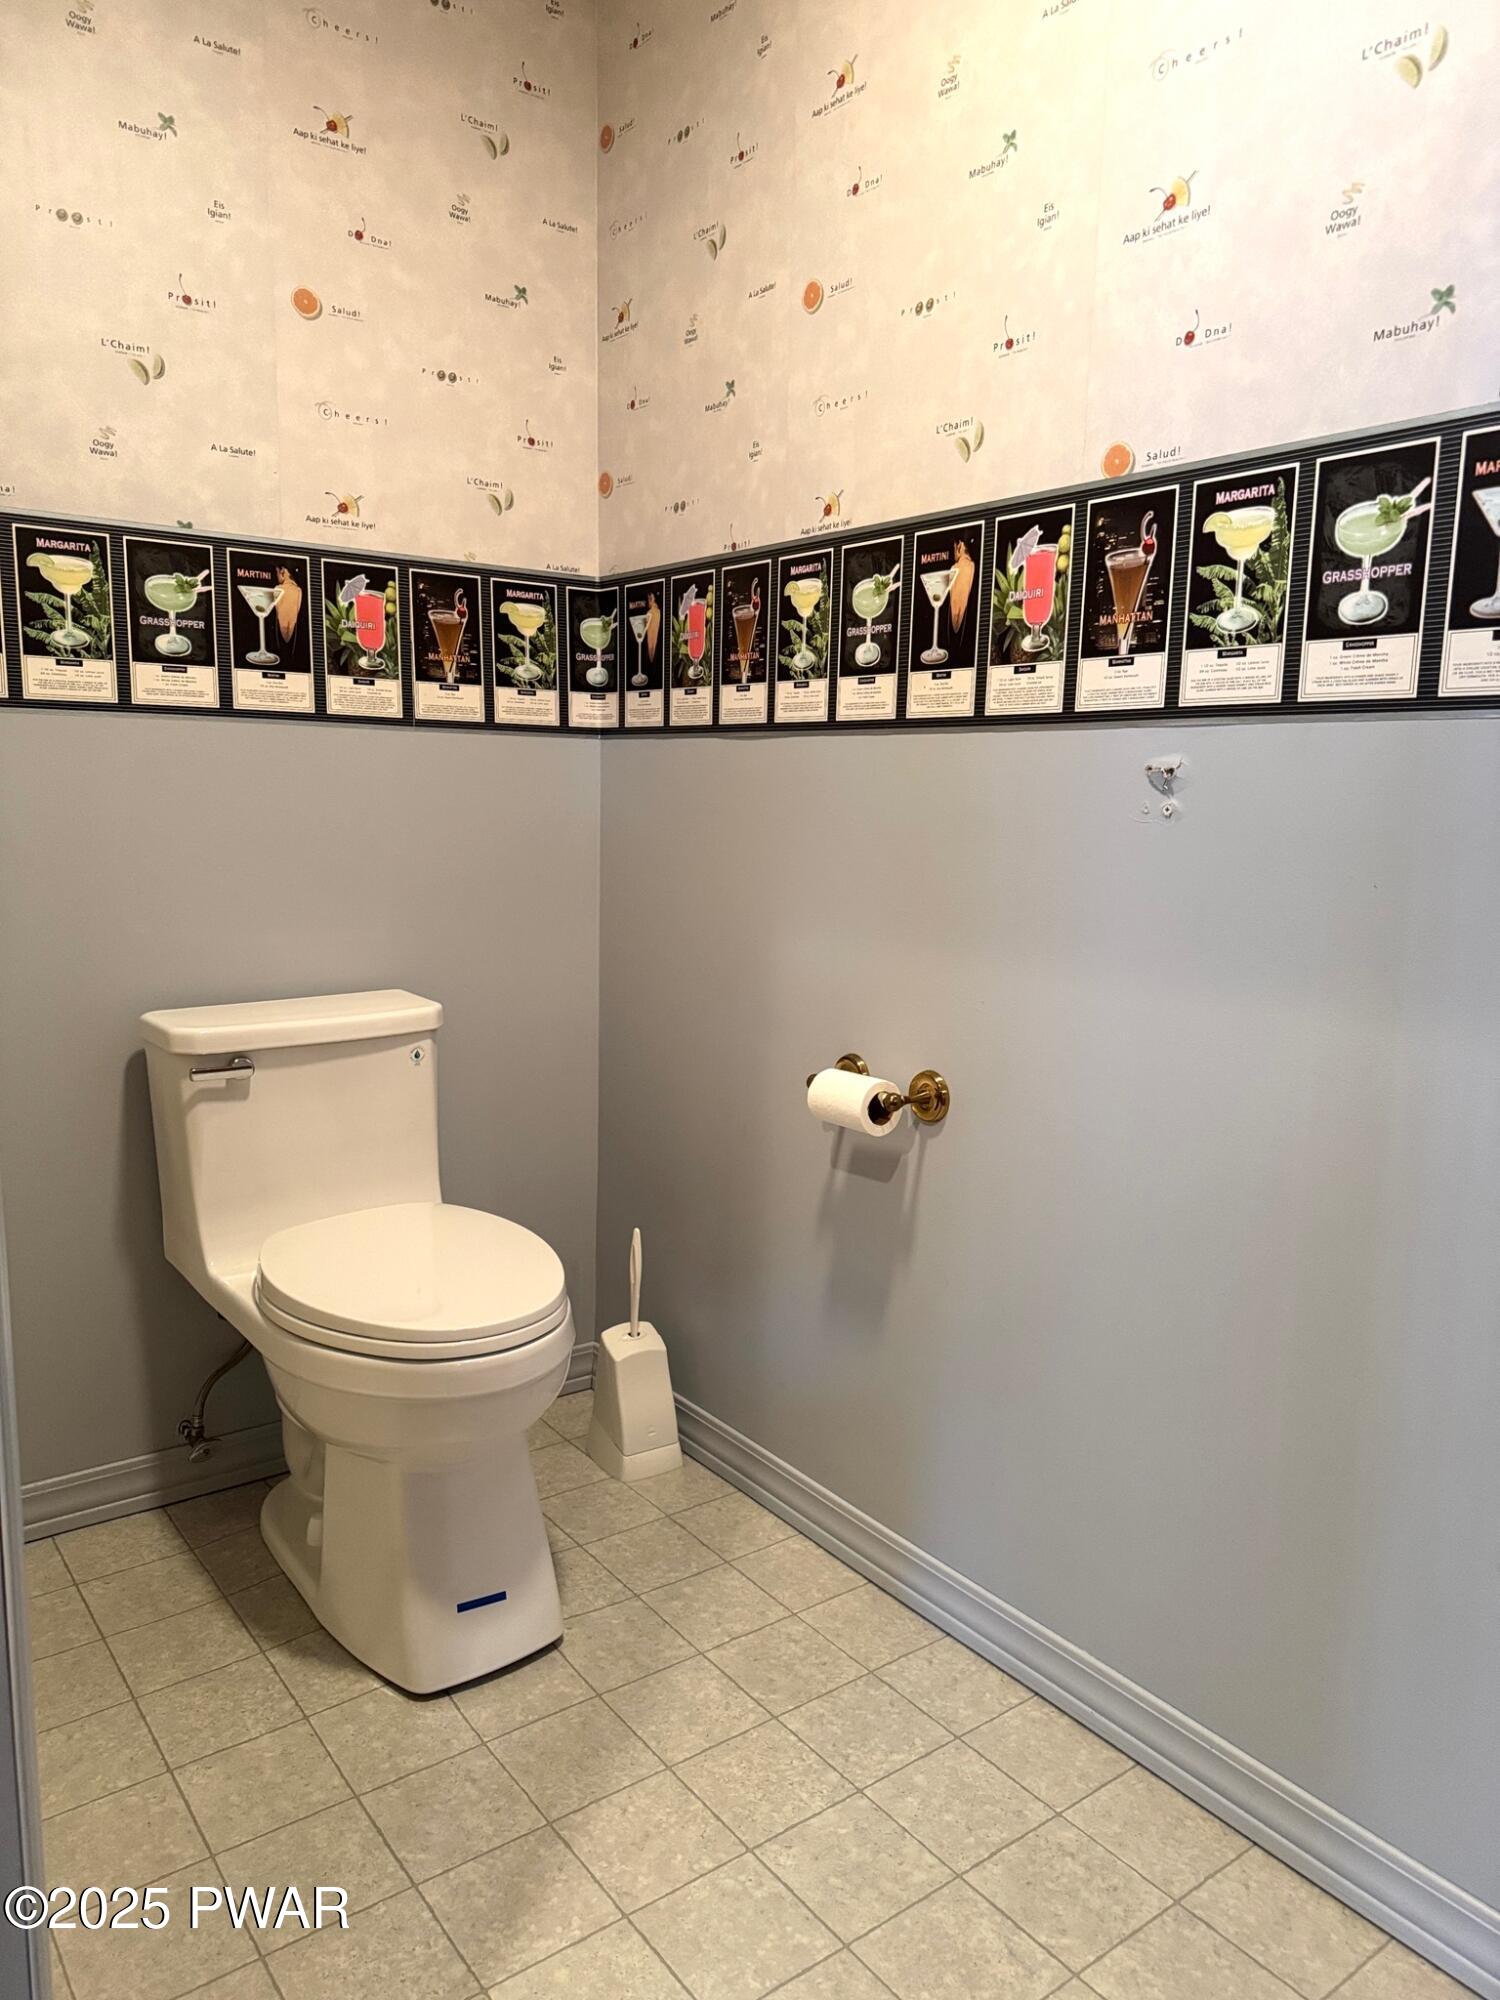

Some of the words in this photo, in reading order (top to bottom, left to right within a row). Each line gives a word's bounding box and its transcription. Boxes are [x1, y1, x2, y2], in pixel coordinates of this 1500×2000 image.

[69, 10, 92, 25] Oogy
[66, 19, 96, 34] Wawa!
[307, 13, 379, 44] Cheers!
[193, 35, 200, 44] A
[202, 37, 212, 48] La
[213, 41, 241, 56] Salute!
[1362, 22, 1429, 62] L'Chaim!
[1156, 28, 1244, 77] Cheers!
[940, 73, 958, 87] Oogy
[937, 82, 960, 98] Wawa!
[811, 106, 824, 118] Aap
[830, 94, 846, 110] sehat
[118, 120, 167, 141] Mabuhay!
[460, 113, 499, 132] L'Chaim!
[293, 127, 309, 140] Aap
[310, 131, 317, 141] ki
[319, 135, 339, 149] sehat
[341, 140, 350, 150] ke
[351, 143, 367, 155] liye!
[968, 155, 1009, 179] Mabuhay!
[213, 200, 225, 210] Eis
[1043, 202, 1055, 213] Eis
[207, 208, 232, 221] Igian!
[1037, 210, 1060, 228] Igian!
[1330, 205, 1358, 222] Oogy
[1123, 229, 1142, 245] Aap
[1142, 224, 1150, 238] ki
[1151, 218, 1176, 235] sehat
[1178, 213, 1189, 227] ke
[1191, 205, 1211, 224] liye!
[1325, 216, 1361, 236] Wawa!
[371, 235, 392, 247] Dna!
[830, 277, 853, 294] Salud!
[484, 293, 521, 309] Mabuhay!
[332, 305, 361, 318] Salud!
[1204, 323, 1233, 339] Dna!
[1373, 316, 1440, 343] Mabuhay!
[101, 338, 150, 354] L'Chaim!
[318, 405, 388, 426] Cheers!
[936, 416, 974, 435] L'Chaim!
[89, 446, 118, 458] Wawa!
[92, 438, 114, 450] Oogy
[211, 443, 218, 452] A
[219, 445, 228, 454] La
[229, 446, 256, 457] Salute!
[1146, 446, 1181, 463] Salud!
[466, 476, 503, 490] L'Chaim!
[1215, 483, 1276, 506] MARGARITA
[306, 514, 321, 525] Aap
[322, 516, 329, 525] ki
[330, 518, 349, 527] sehat
[351, 520, 360, 528] ke
[361, 521, 376, 531] liye!
[36, 537, 91, 553] MARGARITA
[921, 551, 949, 565] MARTINI
[237, 568, 271, 580] MARTINI
[790, 562, 822, 576] MARGARITA
[1322, 562, 1413, 585] GRASSHOPPER
[506, 589, 544, 601] MARGARITA
[1008, 588, 1044, 602] DAIQUIRI
[139, 615, 205, 630] GRASSHOPPER
[1099, 611, 1153, 626] MANHATTAN
[846, 623, 893, 638] GRASSHOPPER
